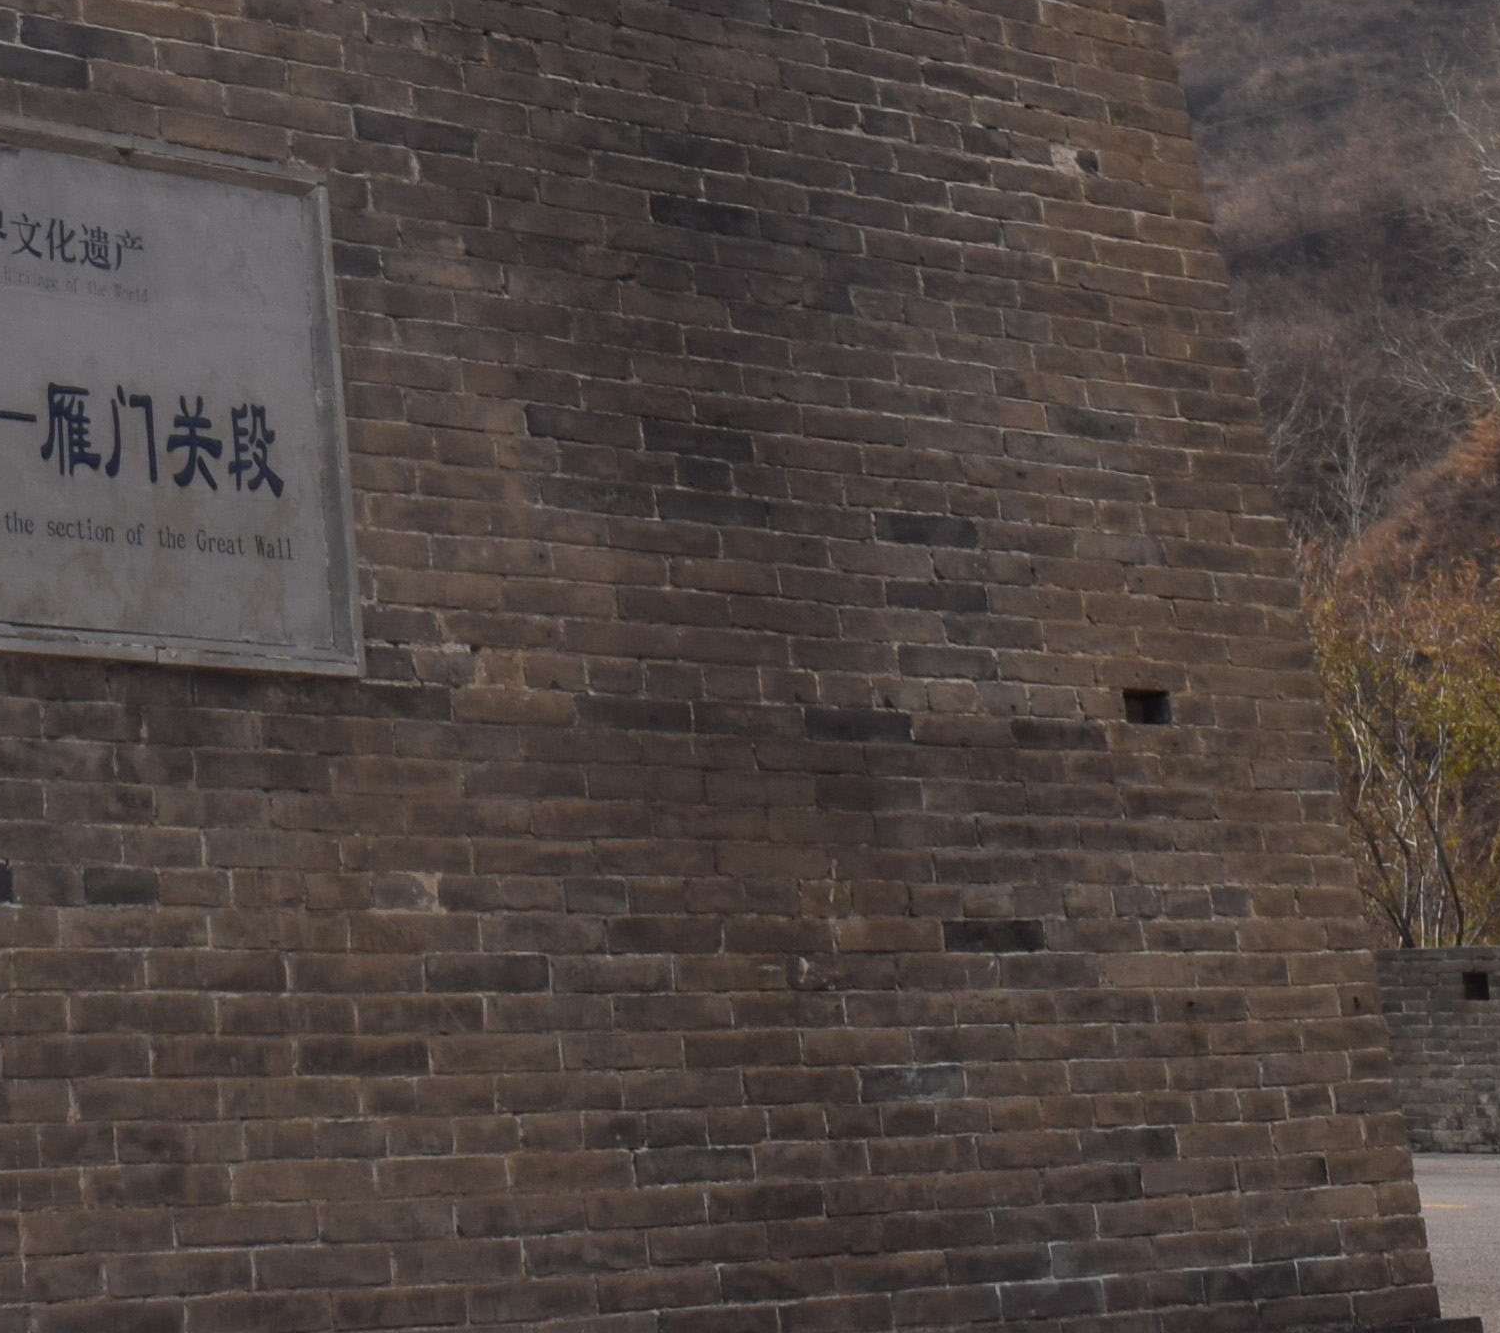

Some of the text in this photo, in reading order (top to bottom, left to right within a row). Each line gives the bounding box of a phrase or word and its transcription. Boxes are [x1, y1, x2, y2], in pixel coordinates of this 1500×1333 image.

[46, 518, 116, 543] section
[126, 523, 146, 546] of
[158, 526, 187, 549] the
[196, 529, 246, 555] Great
[254, 534, 295, 560] Wall
